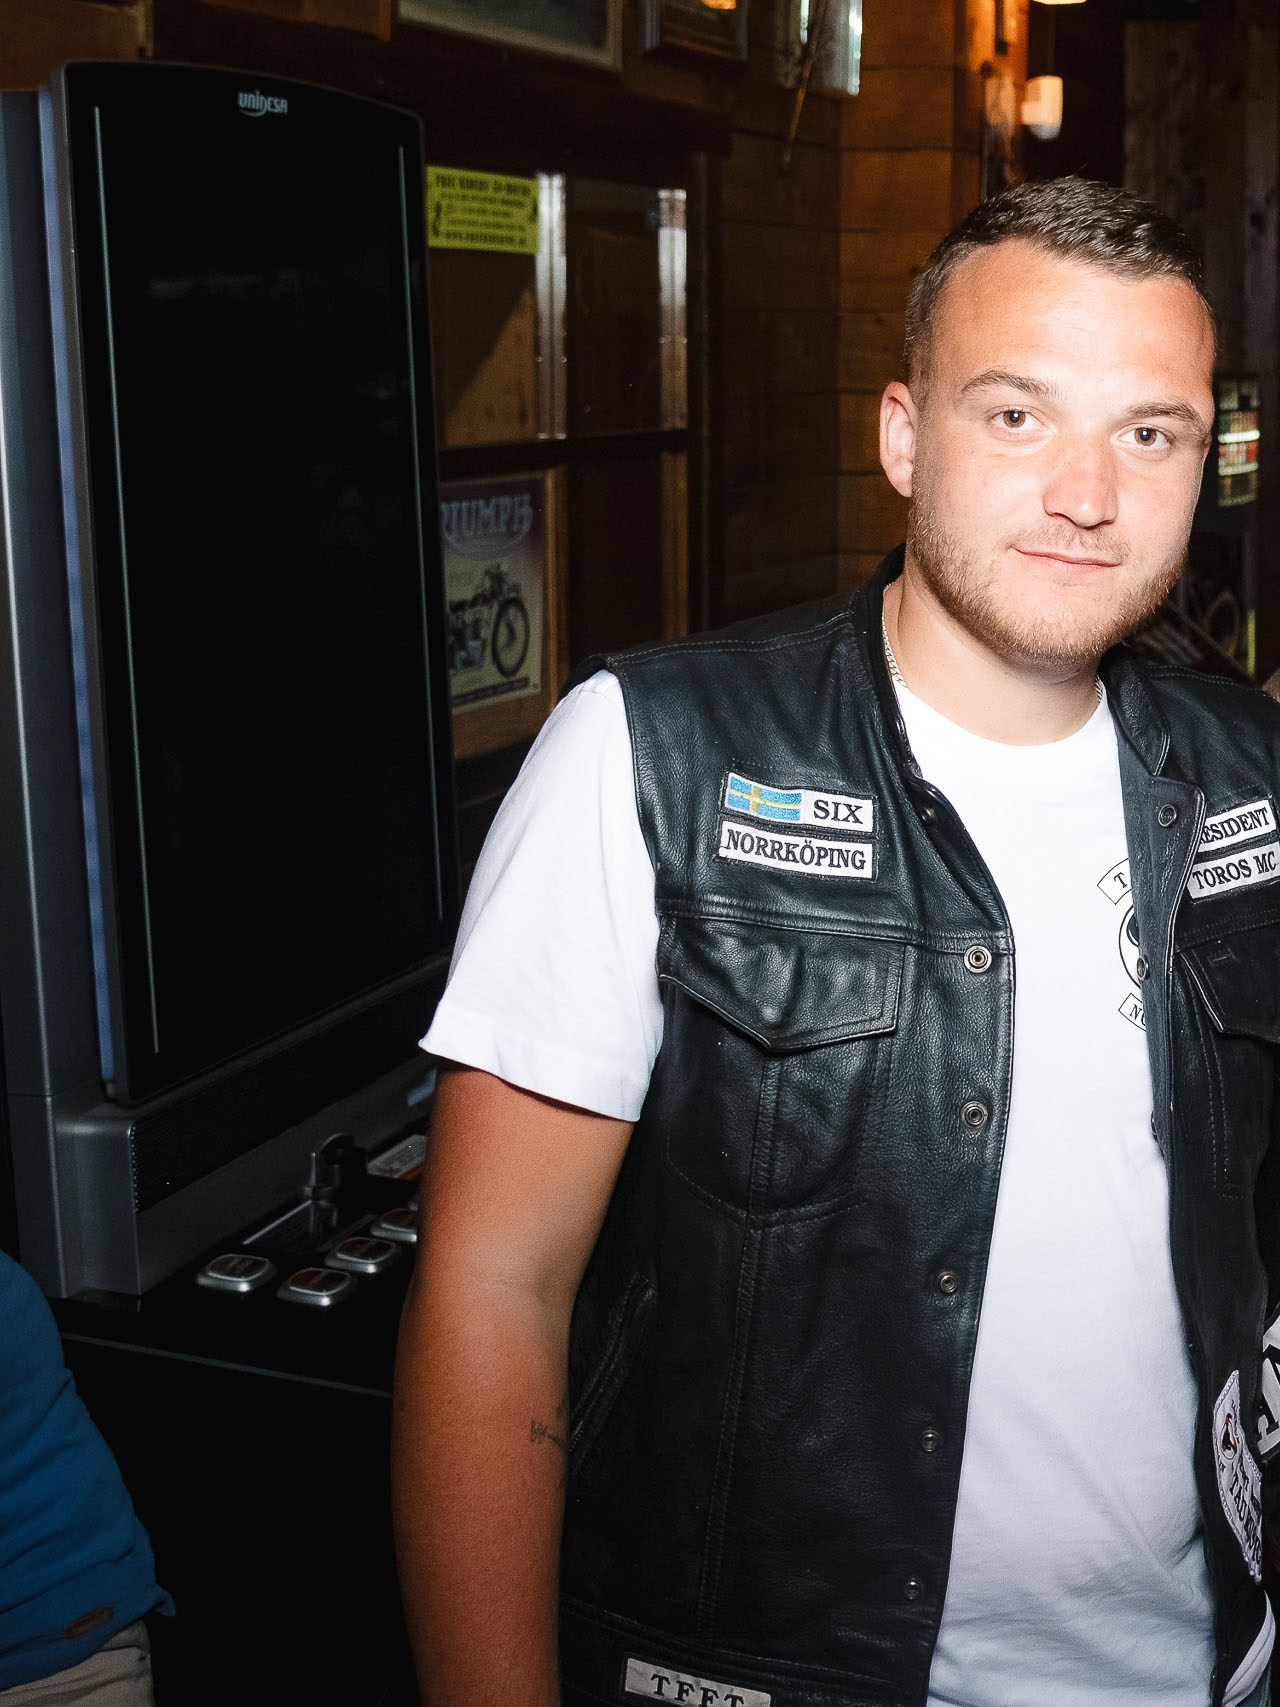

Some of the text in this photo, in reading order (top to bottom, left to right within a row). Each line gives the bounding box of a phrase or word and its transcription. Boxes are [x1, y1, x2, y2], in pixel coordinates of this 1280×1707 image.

[813, 799, 864, 825] SIX
[1199, 807, 1270, 845] ESIDENT
[726, 829, 866, 870] NORRKÖPING
[1192, 851, 1277, 890] TOROS MC
